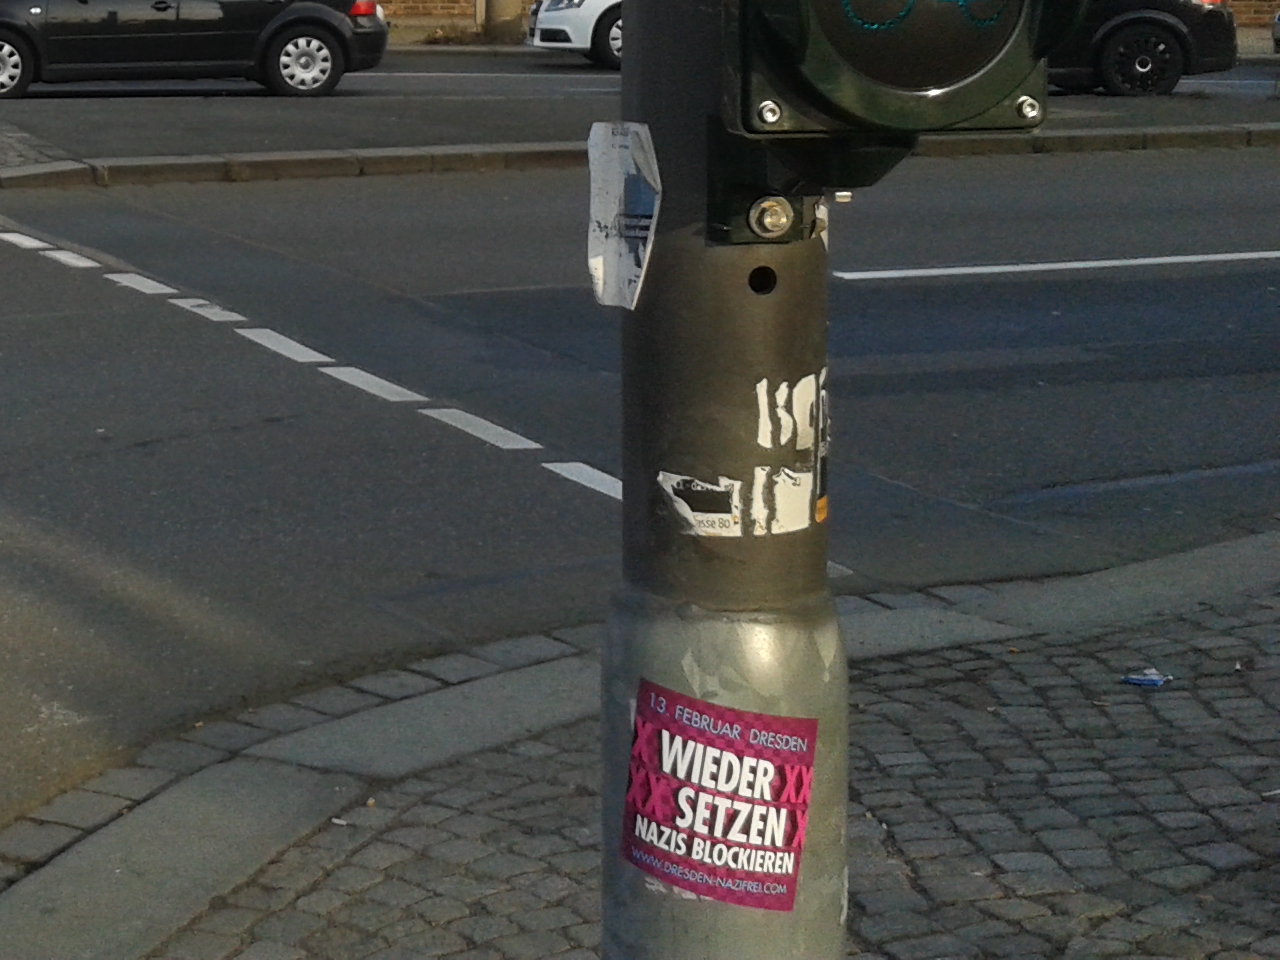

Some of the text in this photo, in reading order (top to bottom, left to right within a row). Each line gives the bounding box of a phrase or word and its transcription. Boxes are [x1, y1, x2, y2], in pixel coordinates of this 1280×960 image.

[718, 517, 731, 529] 80
[649, 692, 807, 753] 13. FEBRUAR DRESDEN
[661, 729, 775, 801] WIEDER
[634, 814, 795, 874] NAZIS BLOCKIEREN
[675, 786, 788, 847] SETZEN
[632, 845, 788, 895] WWW.DRESDEN-NAZIFREI.COM
